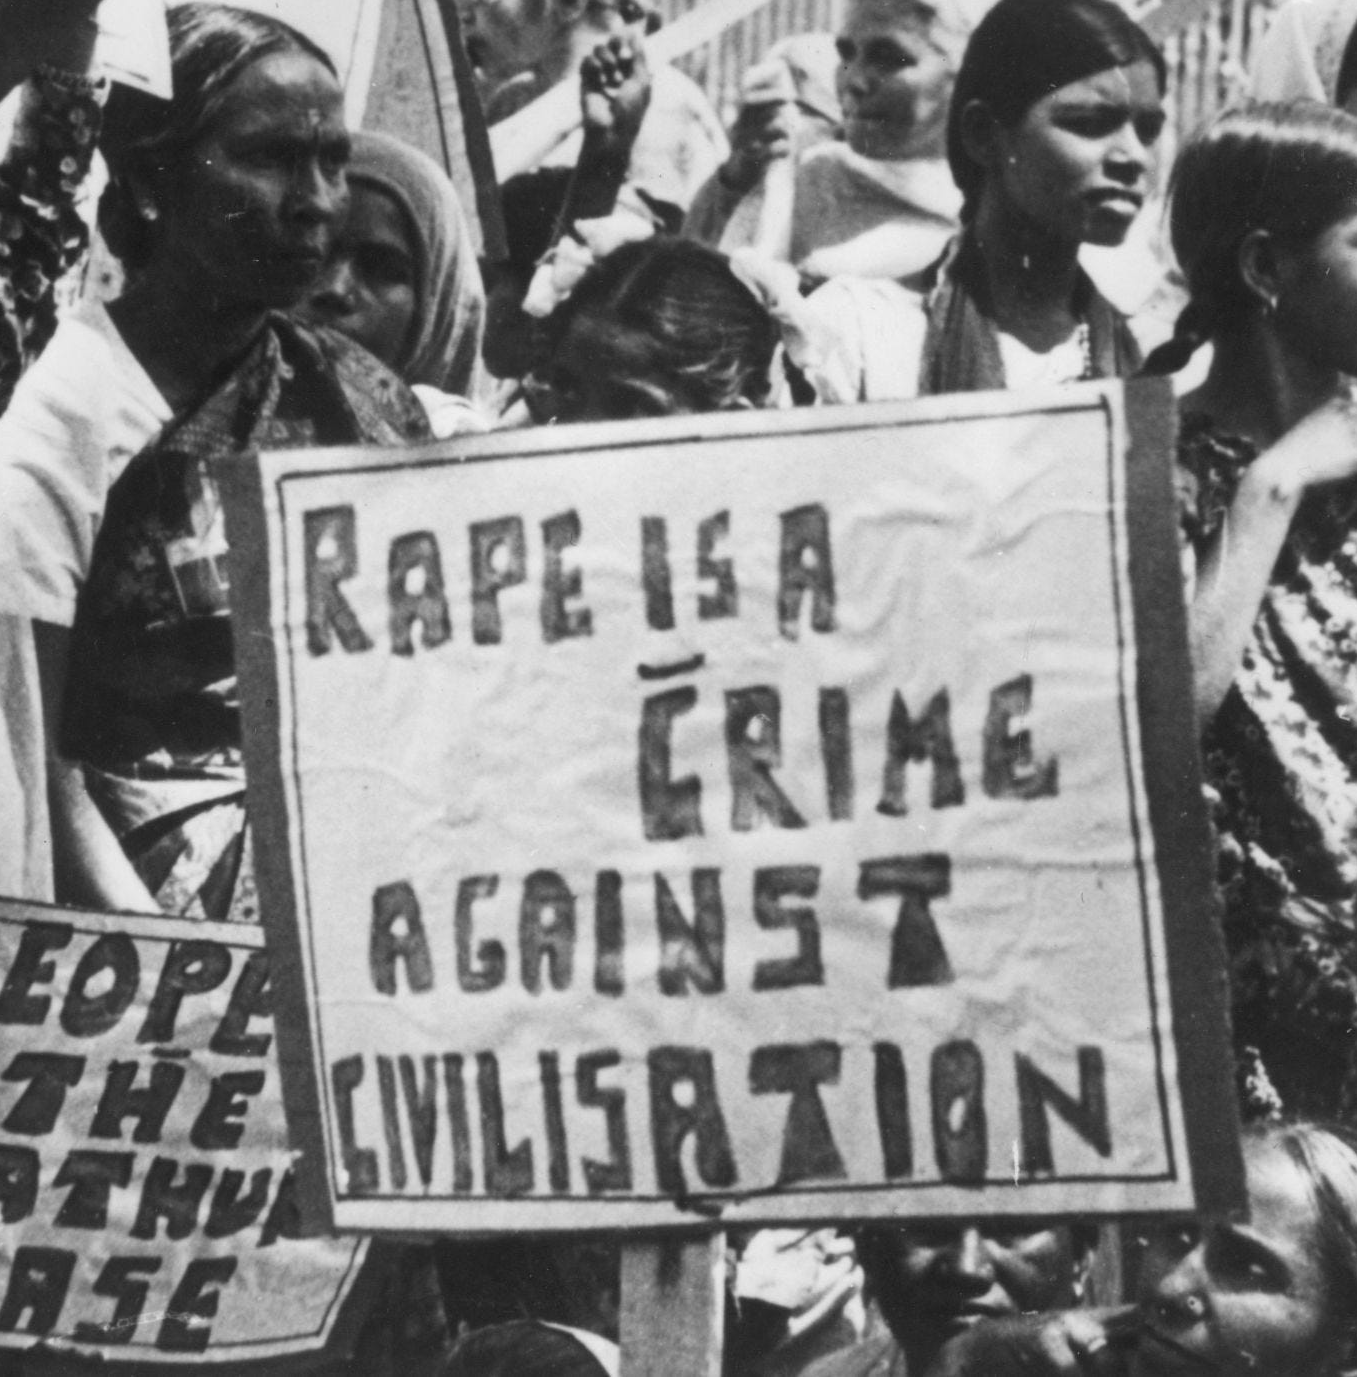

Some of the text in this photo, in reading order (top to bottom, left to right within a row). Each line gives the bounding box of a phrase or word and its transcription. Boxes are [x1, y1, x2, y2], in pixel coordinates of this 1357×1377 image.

[302, 503, 837, 657] RAPE IS A
[636, 673, 1060, 842] CRIME
[368, 852, 954, 998] AGAINST
[0, 1052, 265, 1150] THE
[331, 1039, 1111, 1199] CIVILISATION
